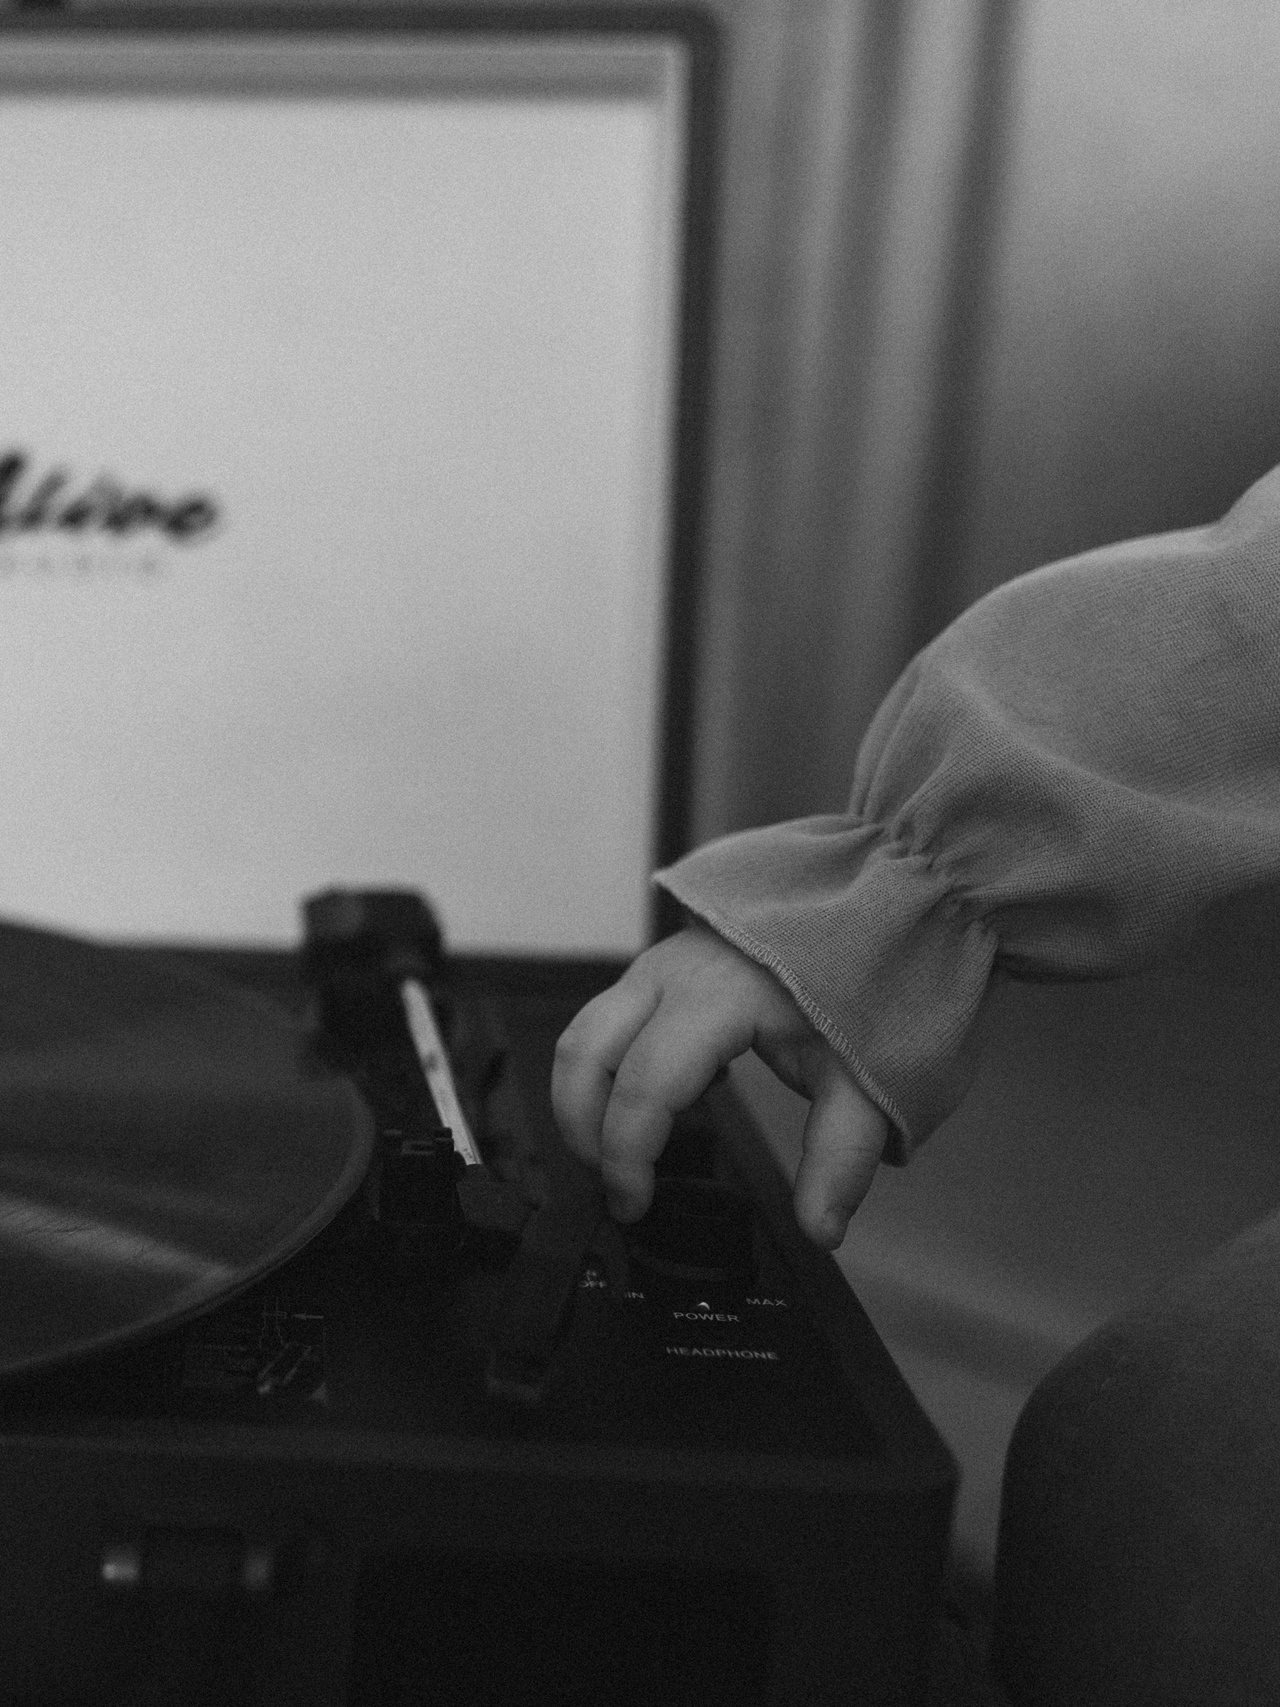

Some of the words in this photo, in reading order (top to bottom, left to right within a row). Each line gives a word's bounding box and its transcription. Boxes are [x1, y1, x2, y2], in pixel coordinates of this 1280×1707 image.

[745, 1297, 788, 1307] MAX
[672, 1311, 740, 1322] POWER
[665, 1346, 778, 1360] HEADPHONE
